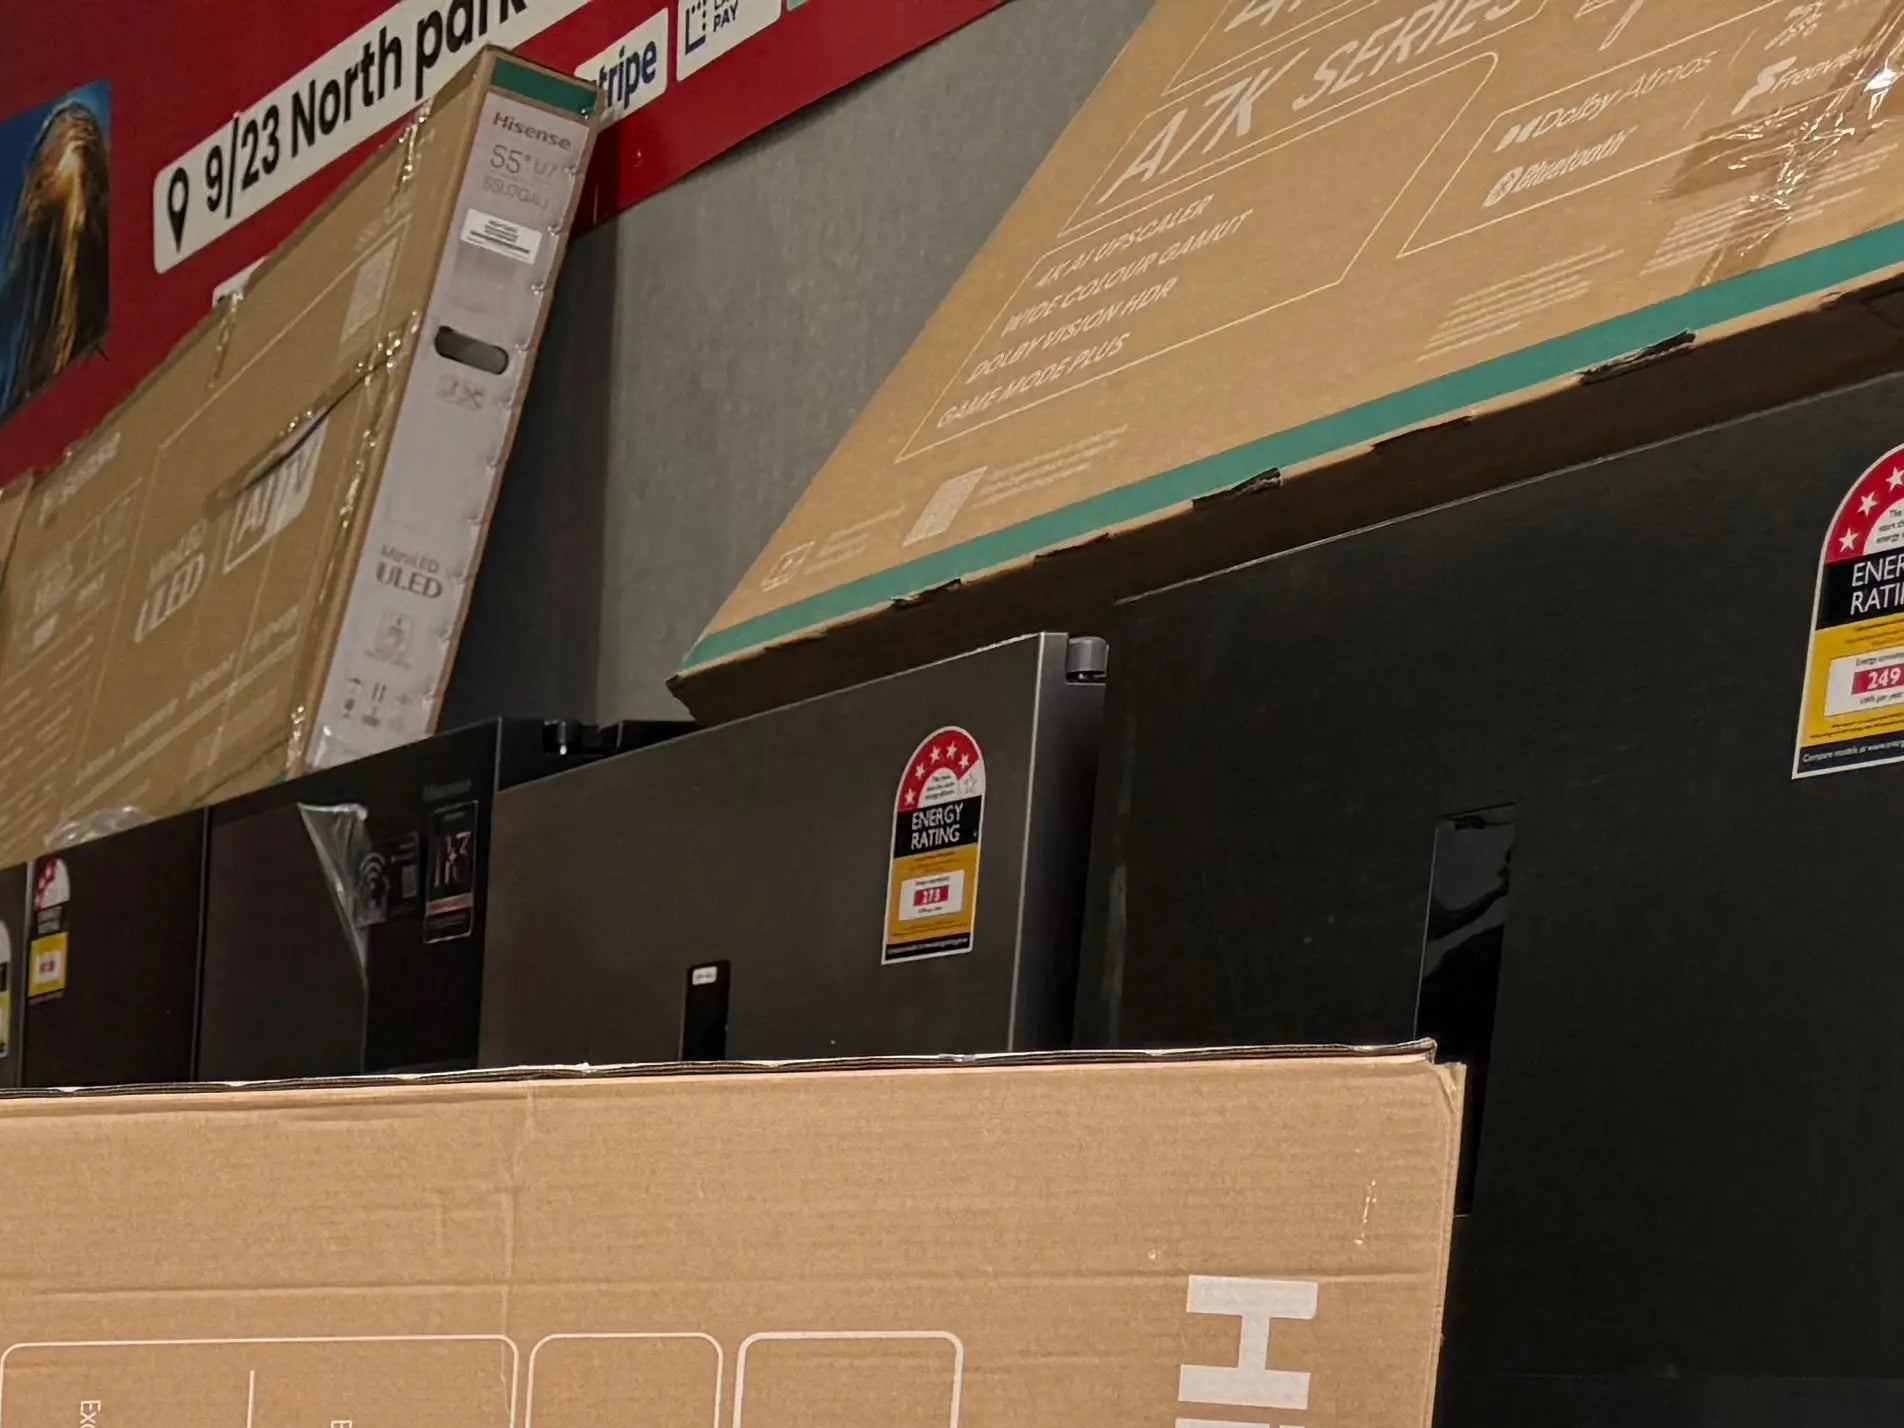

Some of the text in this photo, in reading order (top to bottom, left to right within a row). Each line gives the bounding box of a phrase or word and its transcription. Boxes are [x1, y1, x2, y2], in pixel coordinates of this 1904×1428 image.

[713, 2, 738, 32] PAY
[1532, 51, 1720, 139] Dolby Atmos
[204, 101, 282, 218] 9/23
[290, 27, 404, 160] North
[493, 112, 572, 151] Hisense
[1097, 47, 1310, 204] A7K
[1512, 126, 1638, 192] Bluetooth
[1001, 209, 1254, 336] WIDE COLOUR GAMUT
[376, 567, 443, 599] ULED
[1866, 667, 1901, 690] 249
[911, 803, 963, 830] ENERGY
[911, 824, 961, 850] RATING
